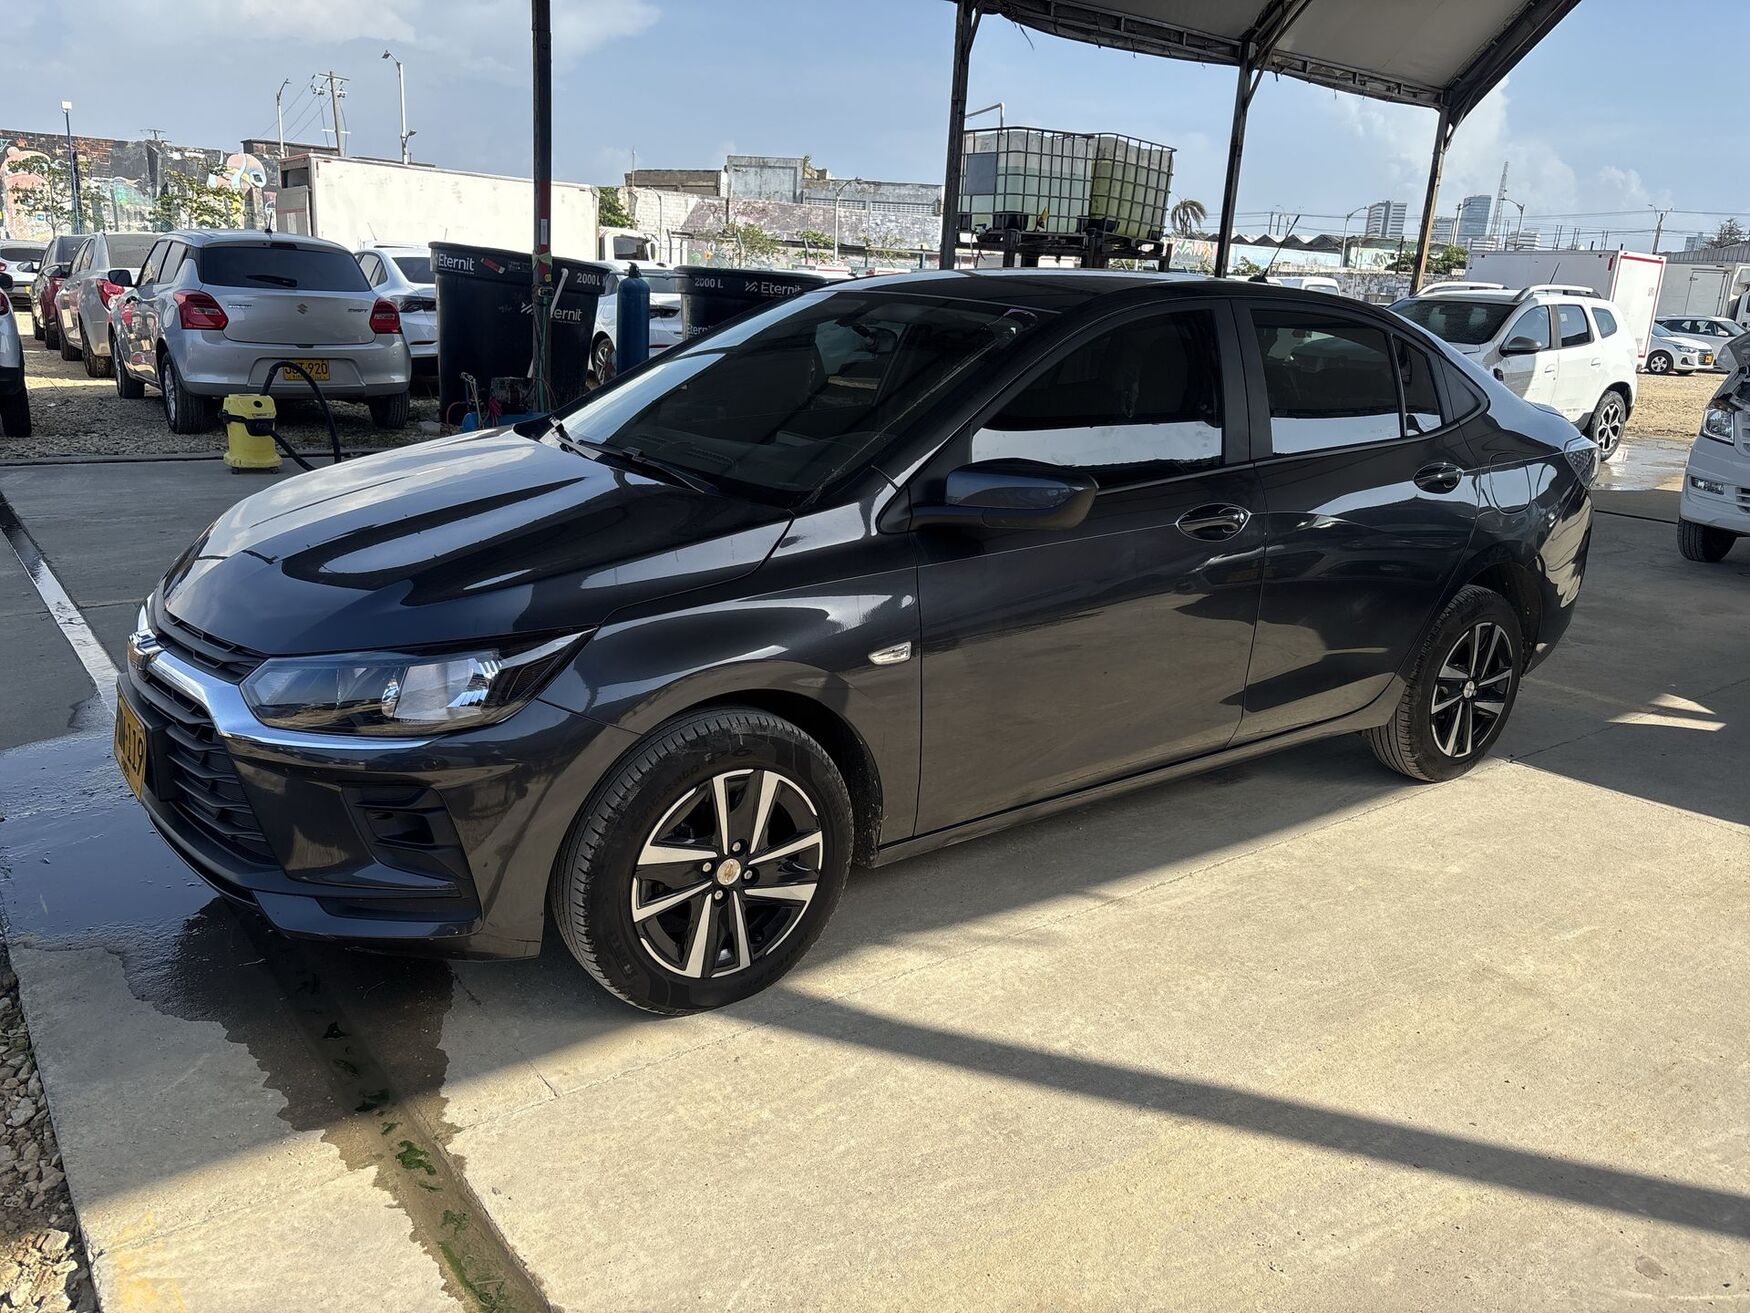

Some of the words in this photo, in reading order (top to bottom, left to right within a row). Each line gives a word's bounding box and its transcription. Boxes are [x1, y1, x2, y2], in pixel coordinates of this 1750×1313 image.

[438, 253, 475, 271] Eternit
[576, 272, 597, 286] 2000
[694, 277, 716, 289] 2000
[717, 279, 724, 289] L
[760, 280, 802, 296] Eternit
[553, 307, 584, 322] ernit
